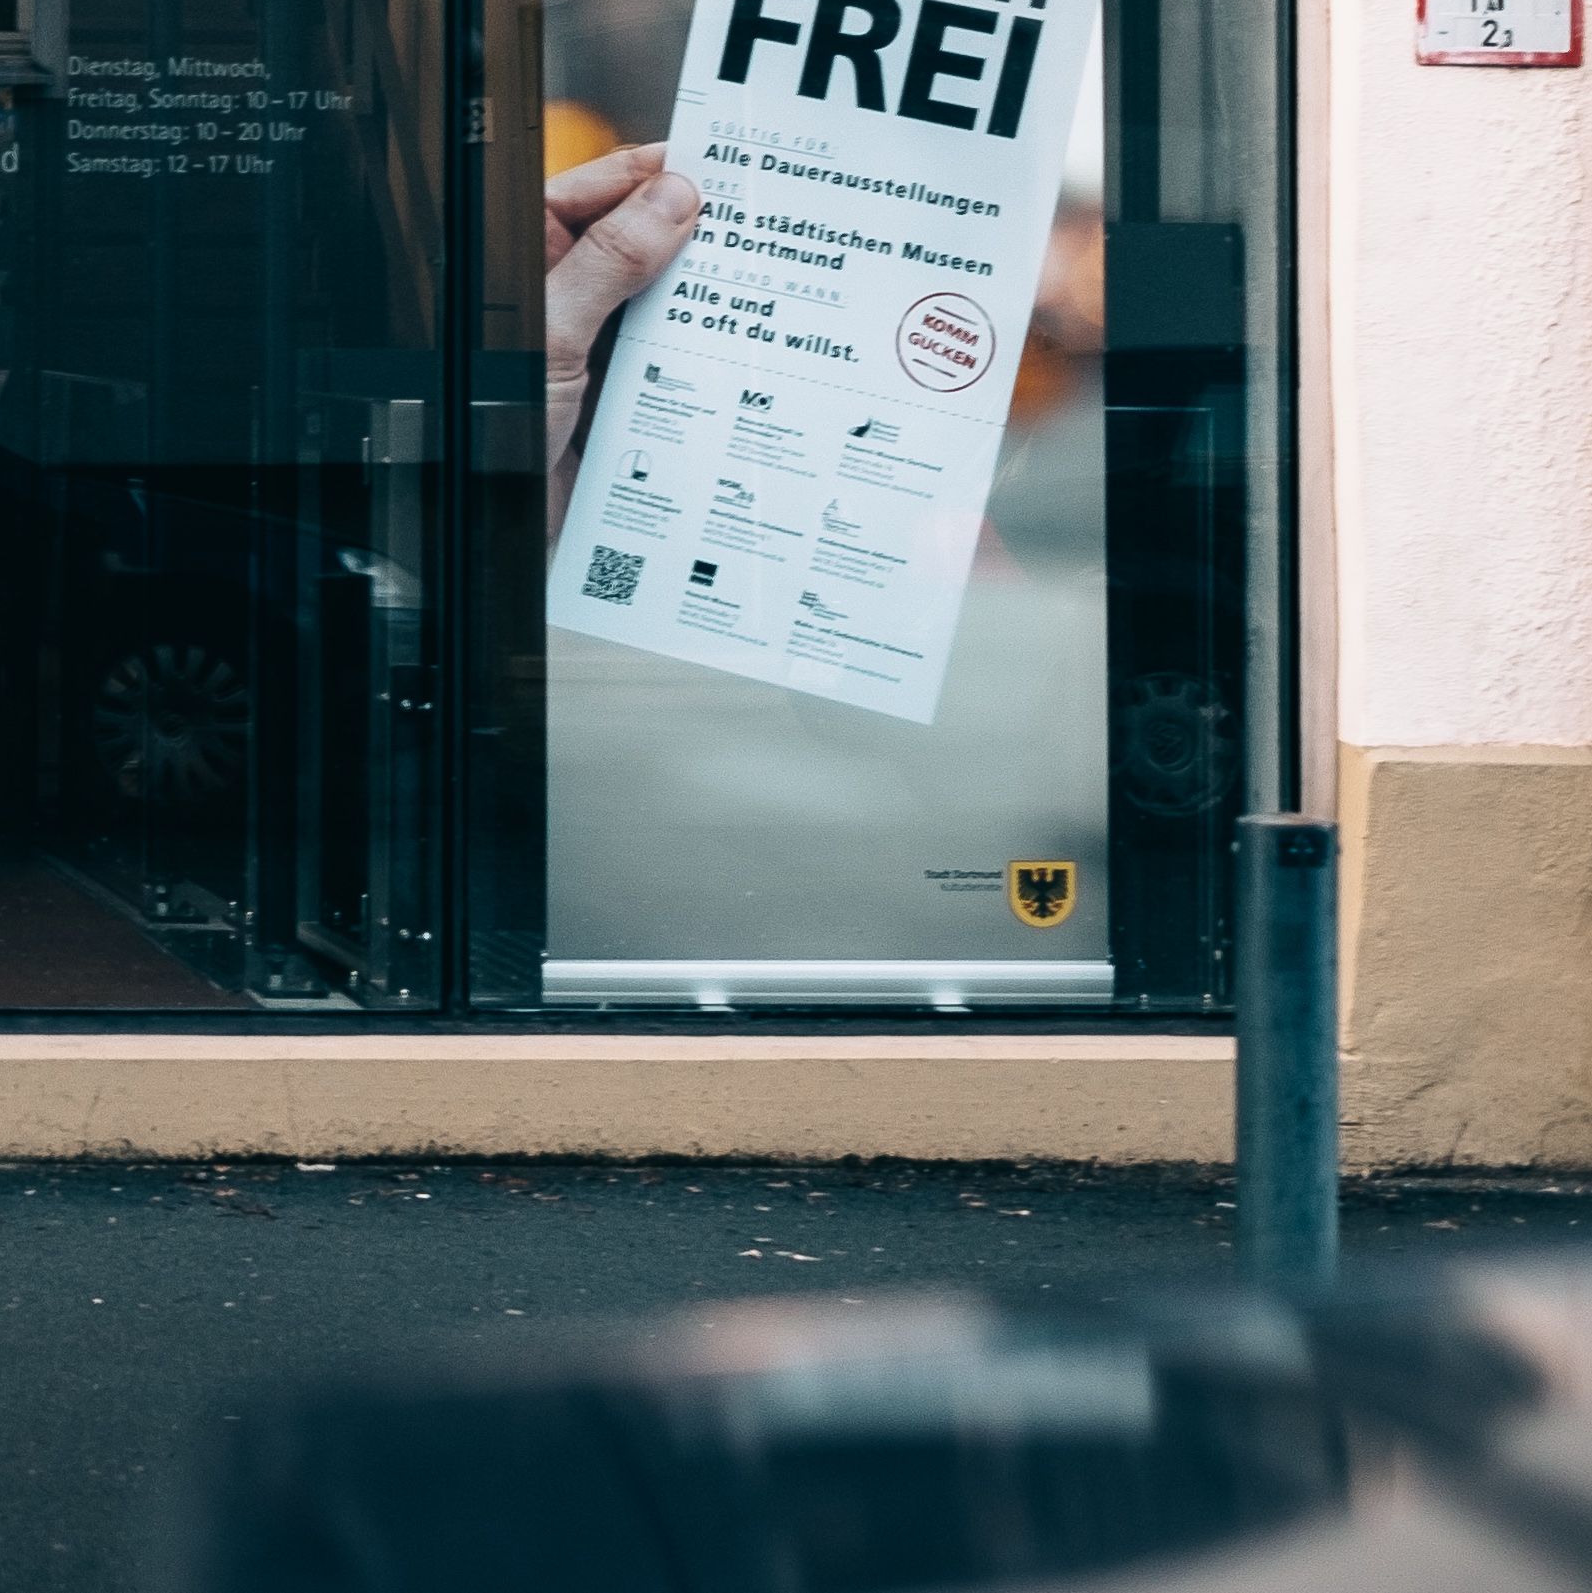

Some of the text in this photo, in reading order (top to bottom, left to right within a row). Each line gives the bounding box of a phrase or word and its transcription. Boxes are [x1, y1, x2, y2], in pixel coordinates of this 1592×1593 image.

[67, 55, 272, 81] Dienstag, Mittwoch,
[67, 88, 143, 114] Freitag,
[149, 88, 240, 114] Sonntag:
[315, 89, 353, 111] Uhr
[67, 119, 189, 146] Donnerstag:
[268, 121, 308, 142] Uhr
[66, 152, 161, 179] Samstag:
[235, 153, 275, 174] Uhr
[702, 143, 1003, 220] Alle Dauerausstellungen
[691, 223, 847, 272] in Dortmund
[698, 201, 995, 278] Alle städtischen Museen
[671, 279, 776, 319] Alle und
[665, 305, 861, 365] so oft du willst.
[922, 313, 980, 347] KOMM
[908, 331, 978, 370] GUCKEN
